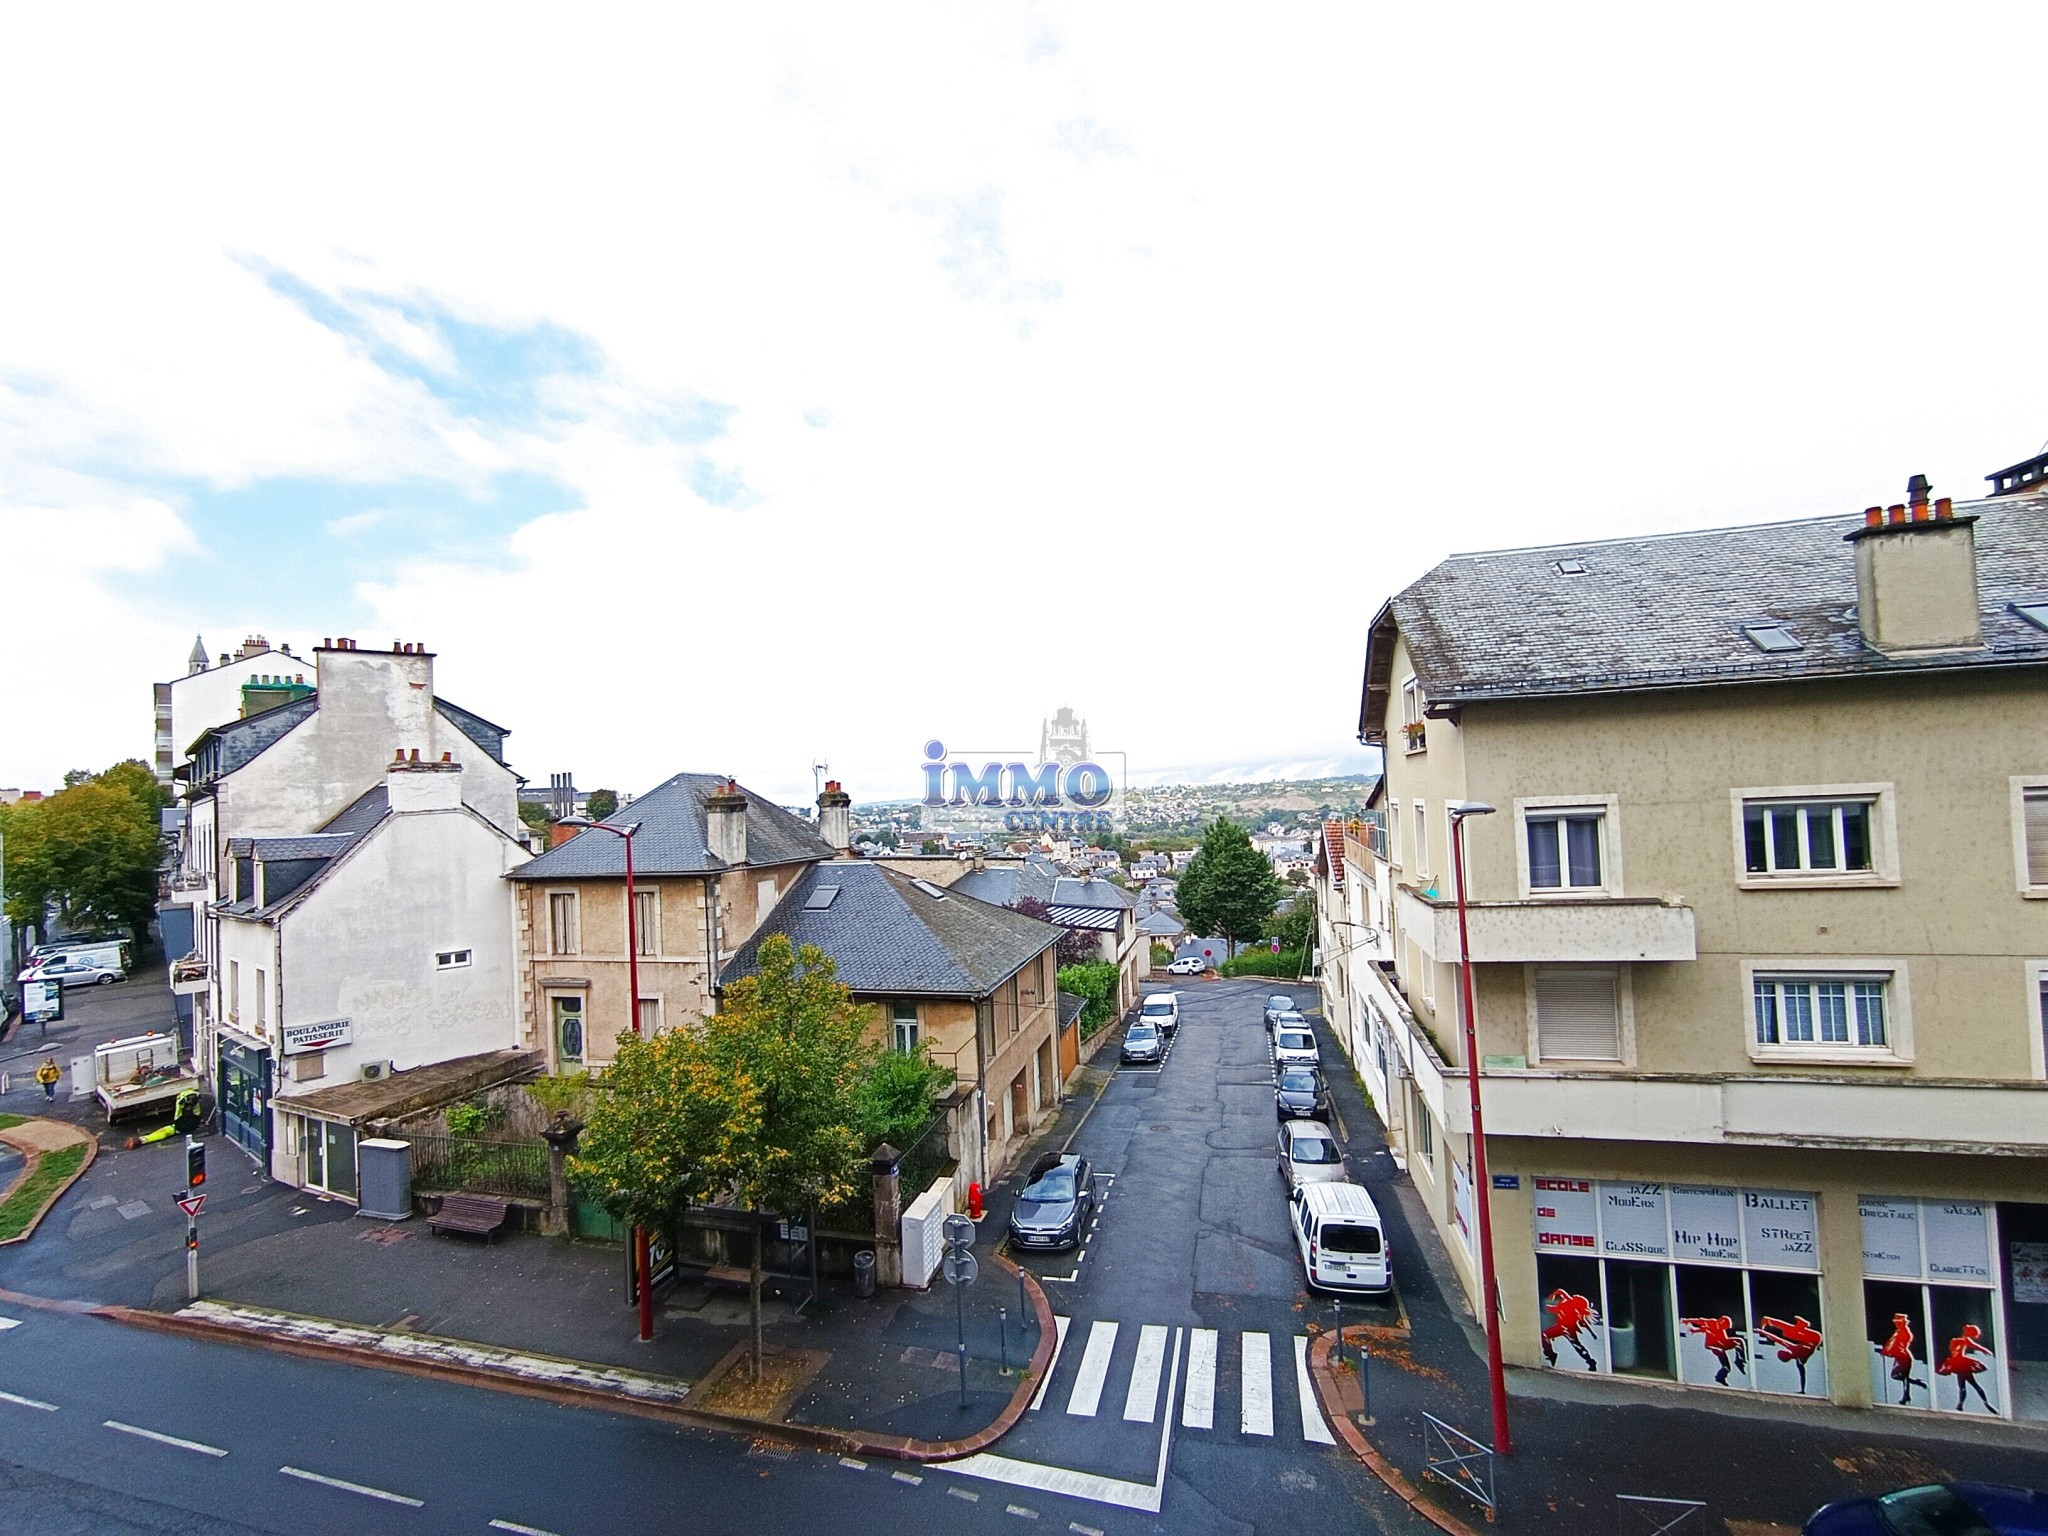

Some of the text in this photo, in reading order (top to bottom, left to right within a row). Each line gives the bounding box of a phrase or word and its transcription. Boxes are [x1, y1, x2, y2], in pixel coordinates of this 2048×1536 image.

[286, 1020, 350, 1038] BOULANGERIE
[292, 1029, 345, 1044] PATISSERIE
[1535, 1179, 1590, 1193] ECOLE
[1626, 1183, 1662, 1196] JAZZ
[1744, 1193, 1809, 1211] BALLET
[1674, 1229, 1738, 1247] HIP HOP
[1761, 1227, 1812, 1241] STREET
[1605, 1240, 1666, 1255] CLASSIQUE
[1781, 1242, 1813, 1254] JAZZ
